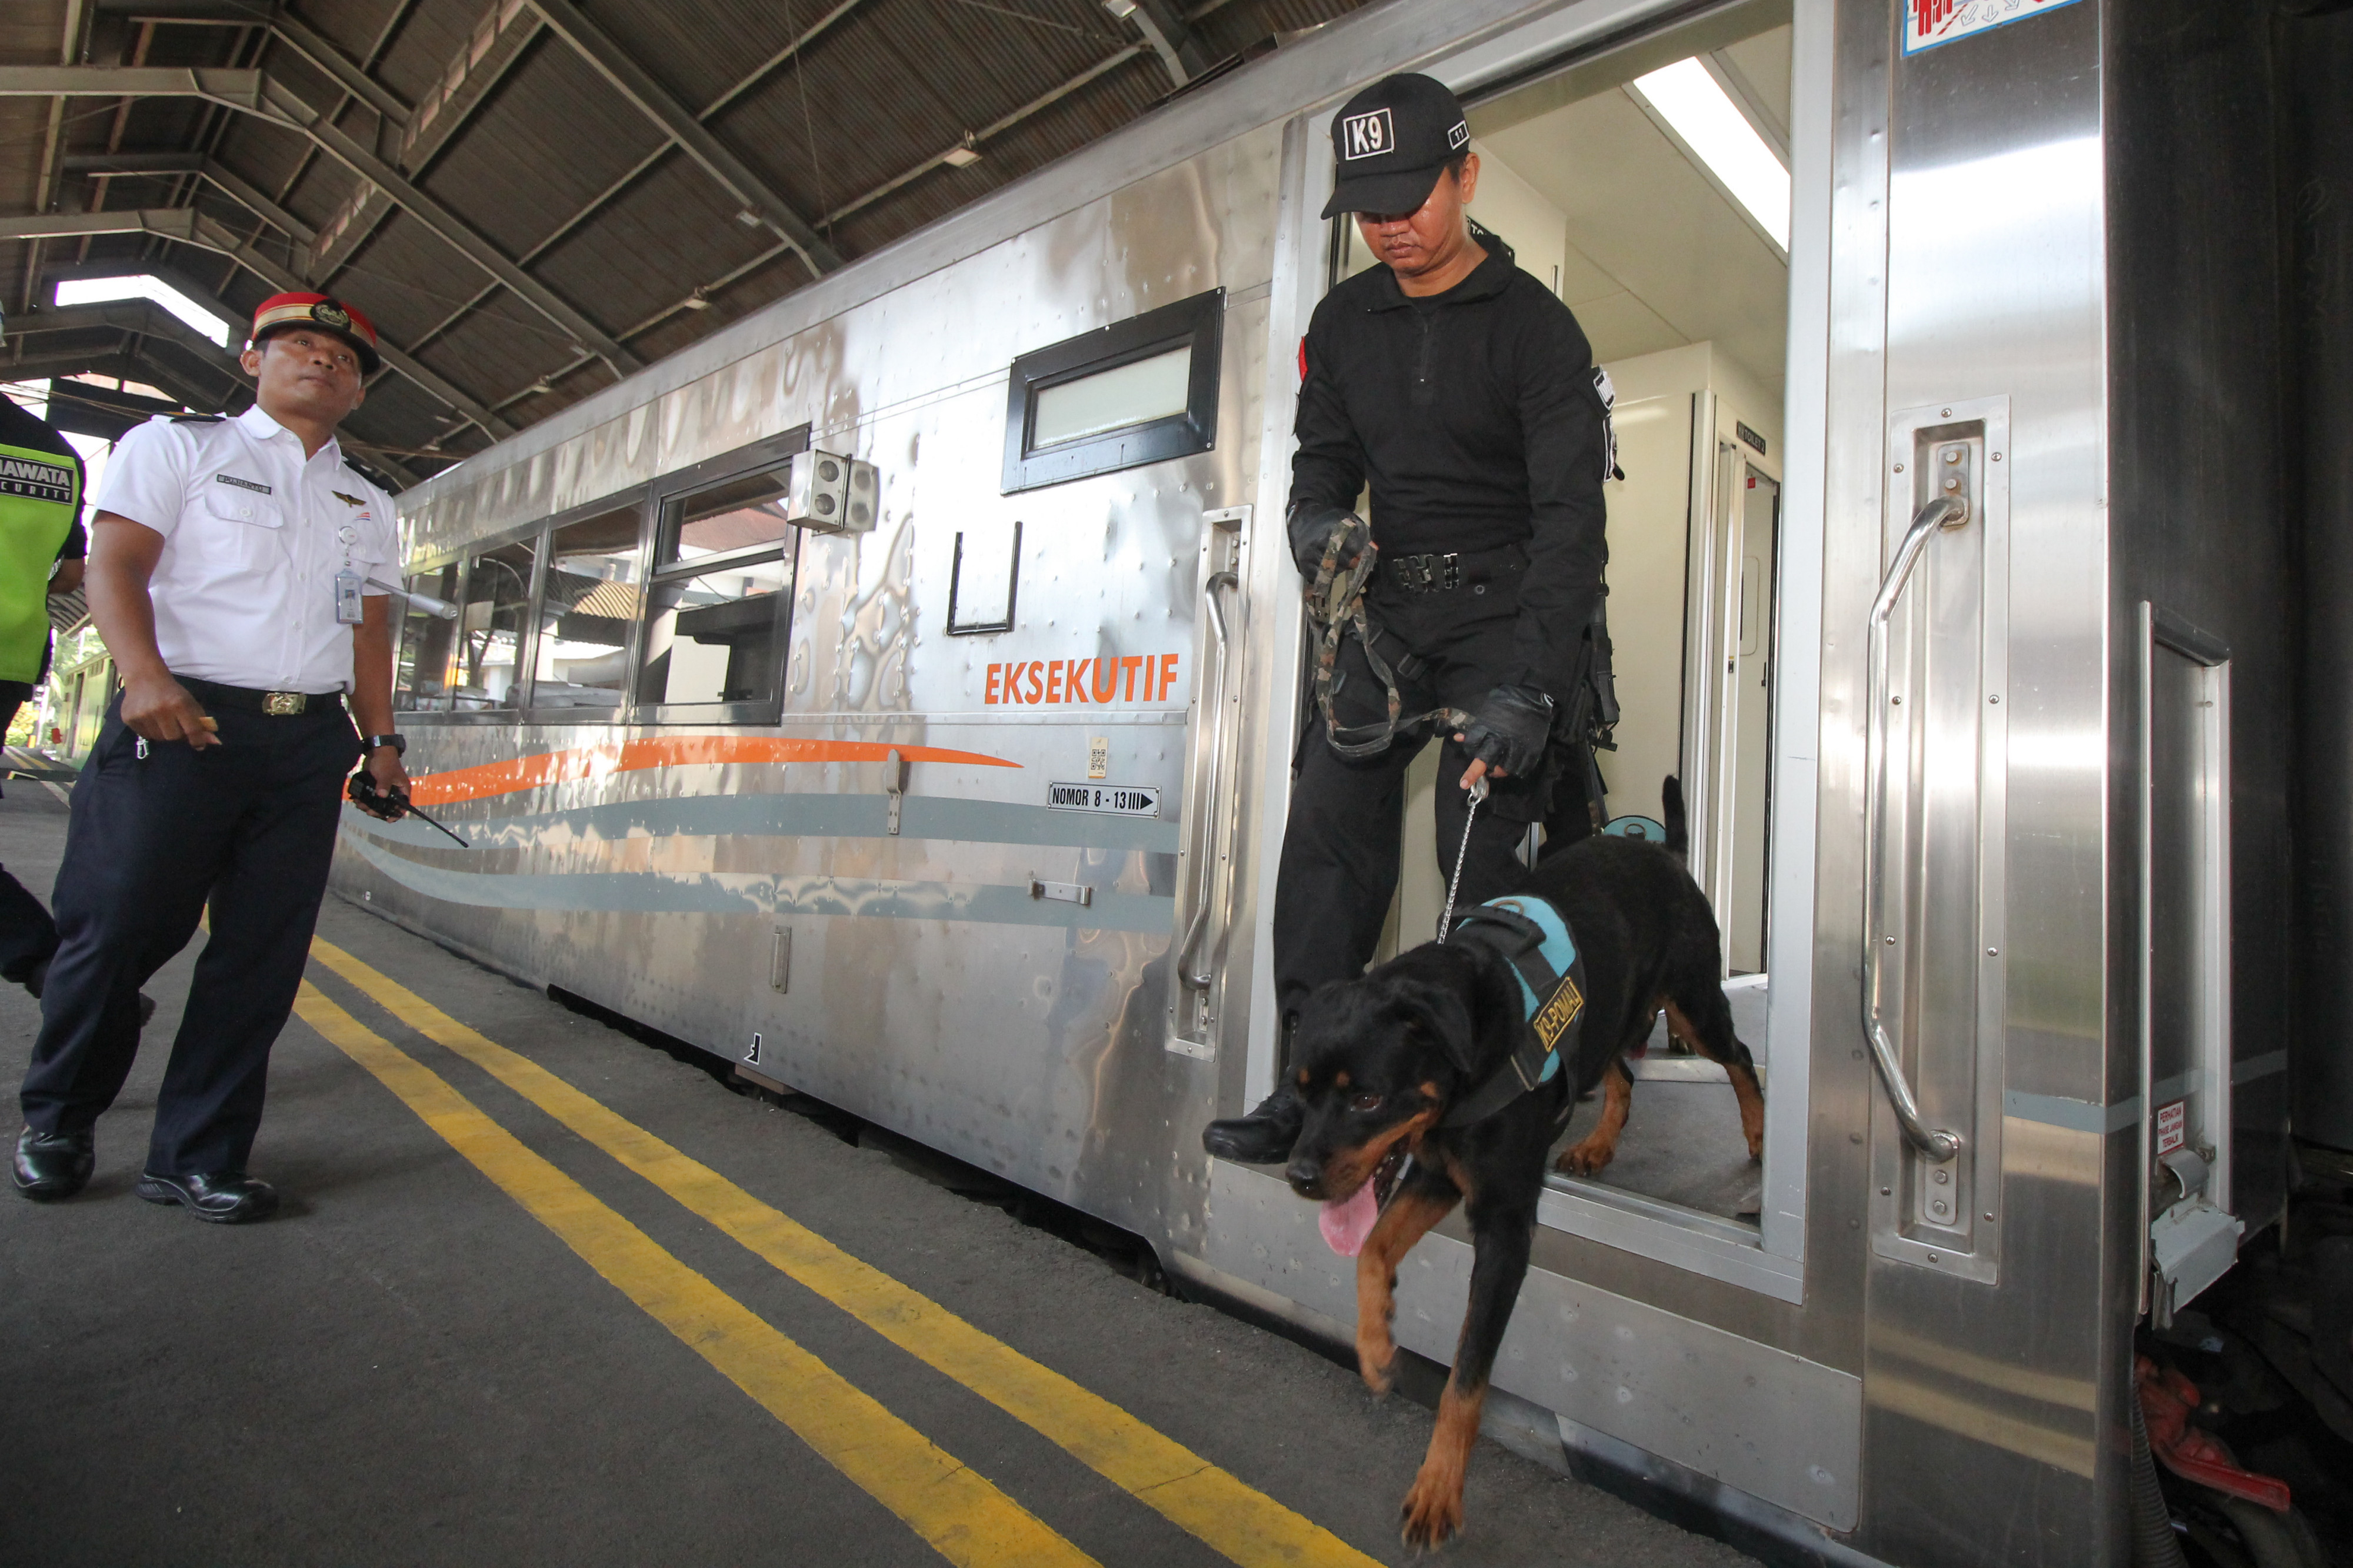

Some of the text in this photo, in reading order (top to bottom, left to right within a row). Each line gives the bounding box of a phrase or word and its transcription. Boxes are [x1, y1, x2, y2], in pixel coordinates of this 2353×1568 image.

[1352, 116, 1382, 154] K9
[1454, 128, 1464, 141] 11
[1744, 429, 1765, 452] TOILET 2
[984, 653, 1179, 705] EKSEKUTIF
[1052, 788, 1089, 806] NOMOR
[1094, 790, 1101, 807] 8
[1535, 985, 1581, 1046] K9-POMAL
[2160, 1106, 2182, 1124] PERHATIAN
[2158, 1125, 2169, 1137] PHASE
[2162, 1133, 2179, 1148] TERBALIK
